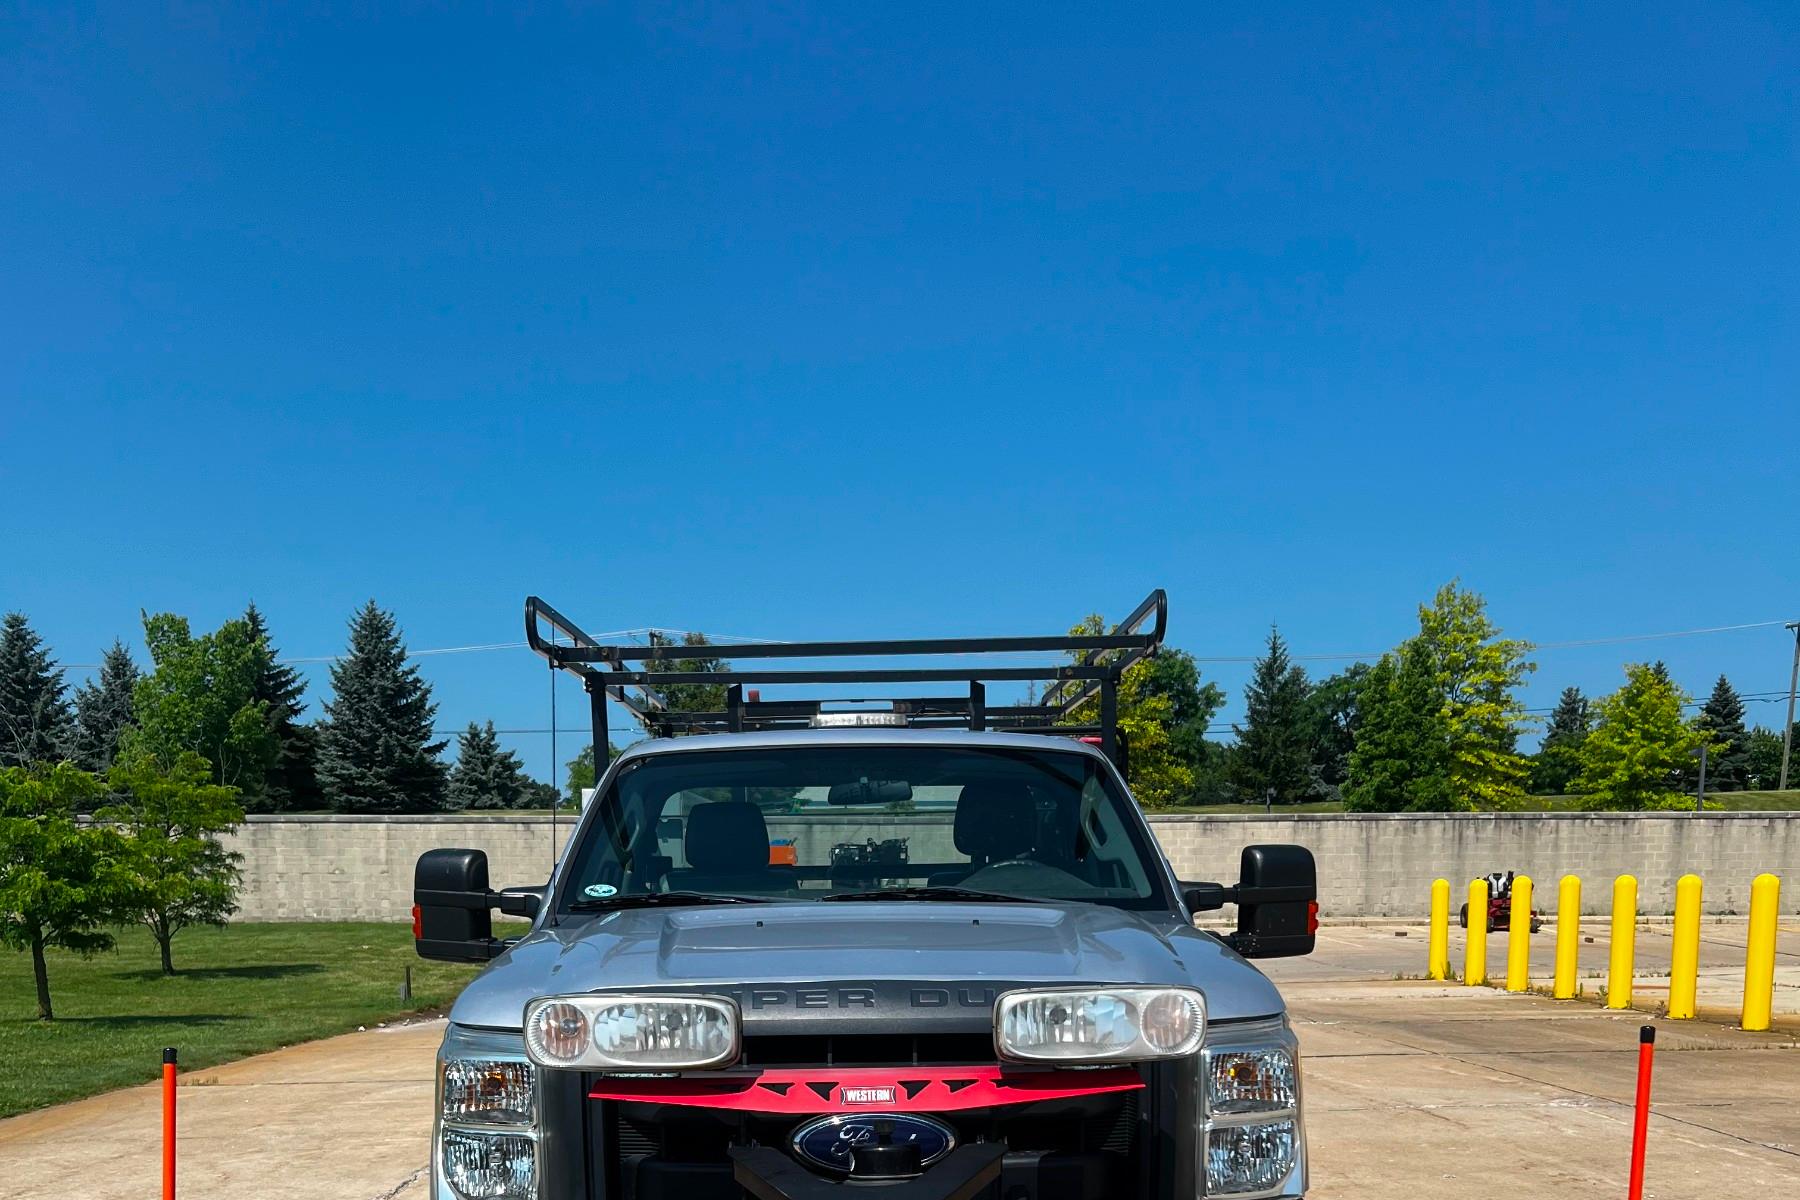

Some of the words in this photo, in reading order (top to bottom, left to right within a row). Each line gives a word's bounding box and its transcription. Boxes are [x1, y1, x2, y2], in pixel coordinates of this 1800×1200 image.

[737, 988, 876, 1010] PER
[909, 986, 995, 1008] DU
[846, 1088, 890, 1102] WESTERN
